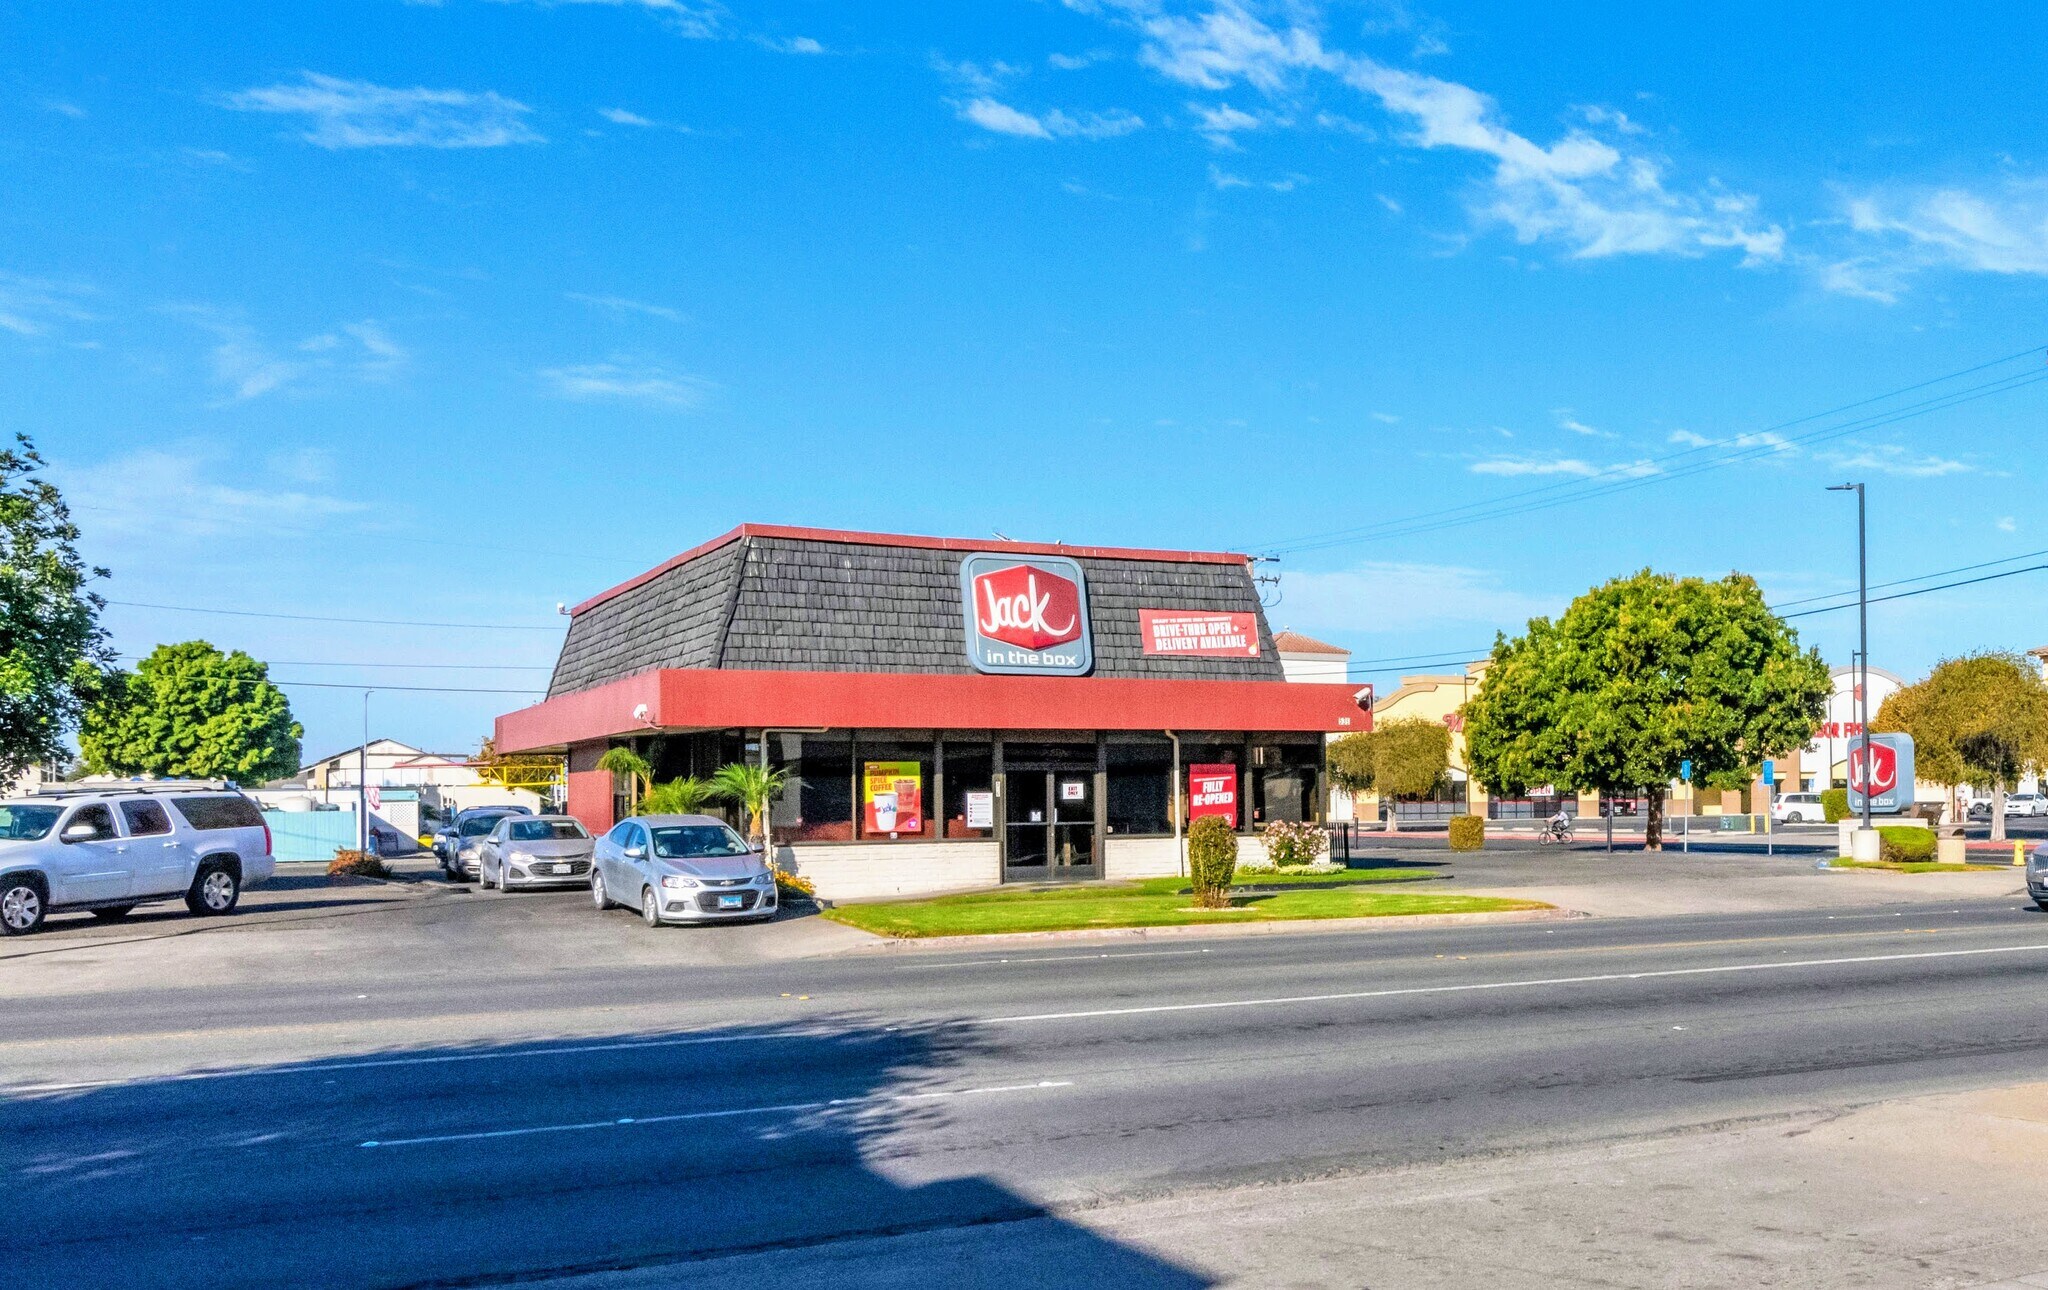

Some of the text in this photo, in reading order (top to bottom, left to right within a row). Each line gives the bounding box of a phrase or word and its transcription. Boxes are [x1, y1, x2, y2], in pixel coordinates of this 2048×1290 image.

[981, 574, 1075, 636] Jack
[1152, 622, 1206, 637] DRIVE-THRU
[1208, 622, 1232, 634] OPEN
[1156, 635, 1246, 651] DELIVERY AVAILABLE
[987, 650, 1076, 666] in the box
[870, 768, 900, 776] PUMPKIN
[1852, 748, 1894, 788] Jak
[870, 783, 892, 792] COFFEE
[1202, 780, 1224, 793] FULLY
[1528, 786, 1551, 794] OPEN
[1192, 792, 1234, 806] RE-OPENED
[1854, 798, 1862, 806] in
[1878, 798, 1894, 806] box
